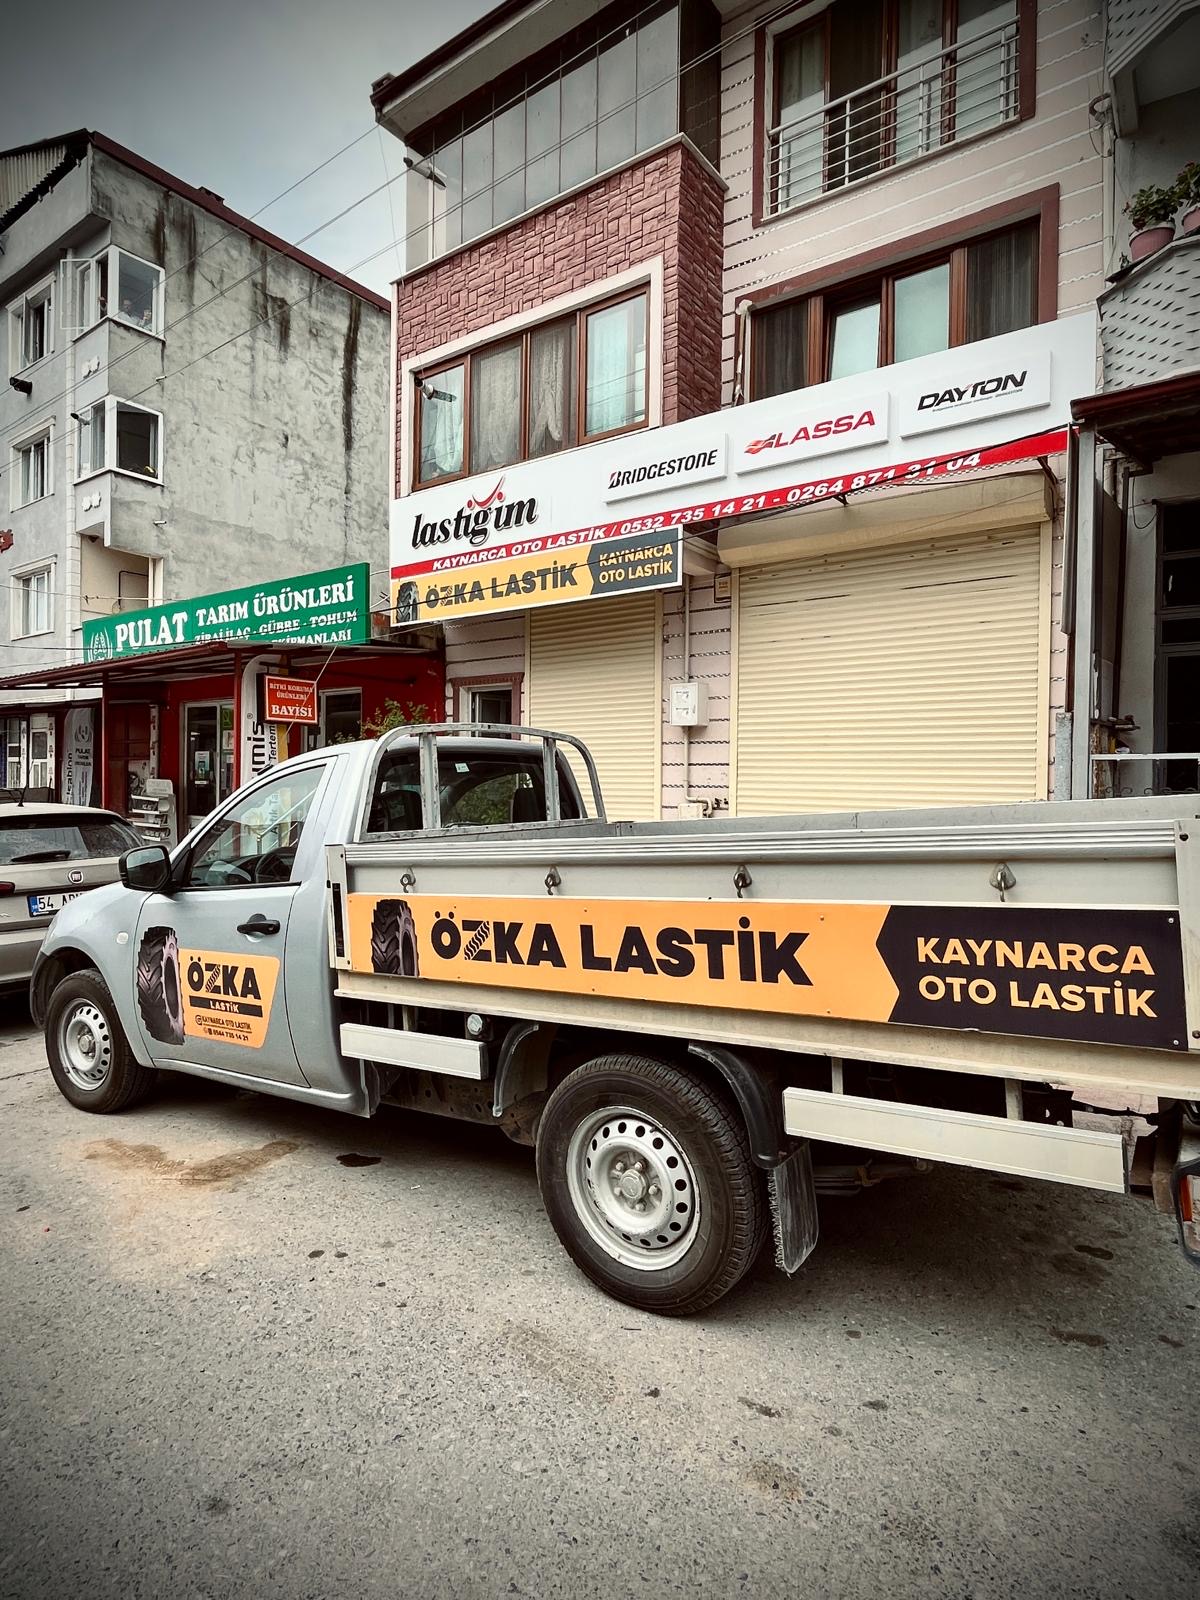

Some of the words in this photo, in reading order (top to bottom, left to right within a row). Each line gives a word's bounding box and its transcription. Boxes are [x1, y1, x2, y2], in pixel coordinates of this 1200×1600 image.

[917, 370, 1028, 411] DAYTON
[774, 410, 876, 449] LASSA
[608, 449, 718, 489] BRIDGESTONE
[432, 547, 507, 571] KAYNARCA
[511, 541, 543, 556] OTO
[546, 526, 606, 549] LASTİK
[620, 516, 664, 535] 0532
[671, 508, 705, 526] 735
[712, 502, 735, 517] 14
[742, 496, 765, 512] 21
[786, 479, 844, 503] 0264
[851, 468, 896, 490] 871
[905, 460, 937, 479] 31
[946, 452, 981, 471] 04
[599, 543, 673, 567] KAYNARCA
[599, 569, 625, 584] OTO
[628, 559, 673, 581] LASTİK
[426, 578, 484, 609] ÖZKA
[491, 561, 578, 599] LASTİK
[115, 611, 188, 652] PULAT
[195, 600, 249, 627] TARIM
[253, 575, 354, 617] ÜRÜNLERİ
[258, 619, 301, 636] GÜBRE
[309, 609, 358, 628] TOHUM
[271, 703, 313, 718] BAYİSİ
[38, 896, 54, 910] 54
[431, 911, 567, 968] ÖZKA
[580, 916, 814, 986] LASTİK
[917, 936, 1155, 976] KAYNARCA
[187, 955, 262, 1001] ÖZKA
[919, 975, 997, 1005] OTO
[1009, 980, 1158, 1018] LASTİK
[210, 1001, 240, 1013] LASTİK
